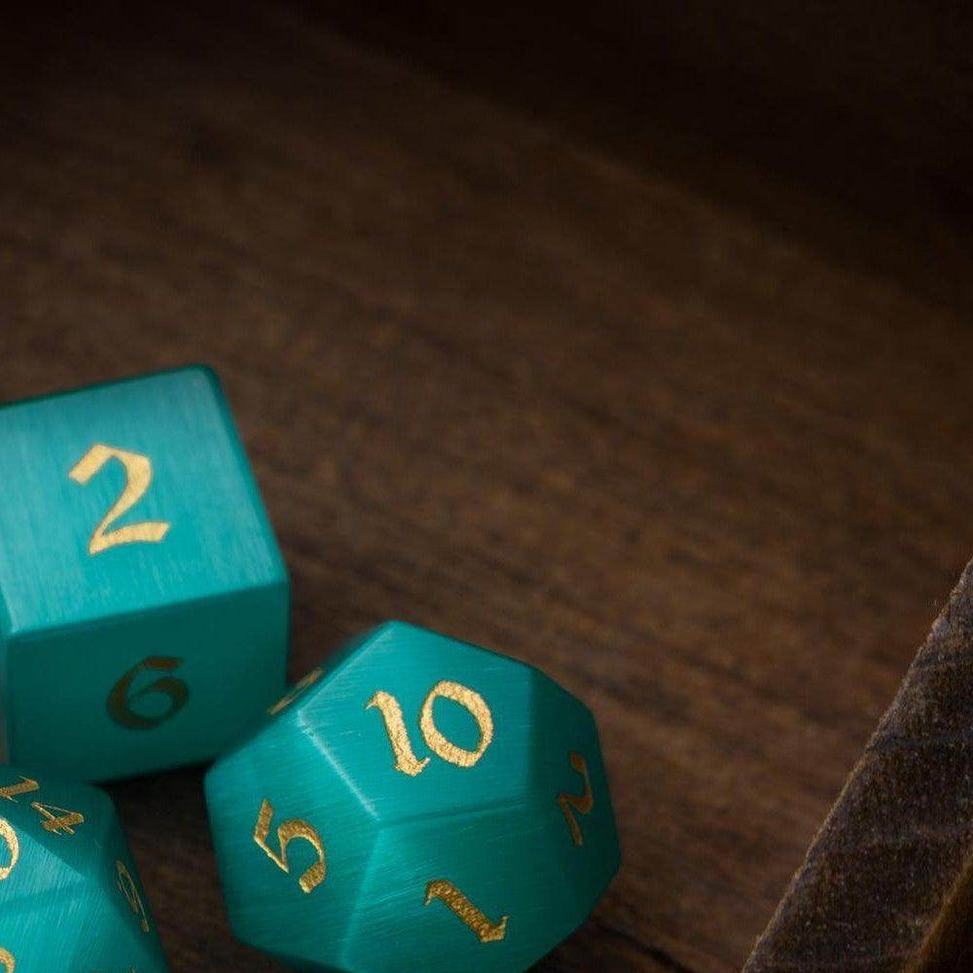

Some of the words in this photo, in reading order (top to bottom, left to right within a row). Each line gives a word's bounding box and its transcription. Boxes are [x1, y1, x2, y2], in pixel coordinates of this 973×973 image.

[68, 443, 170, 555] 2
[106, 655, 190, 730] 6
[365, 680, 494, 776] 10
[254, 798, 326, 893] 5
[426, 880, 509, 943] 1
